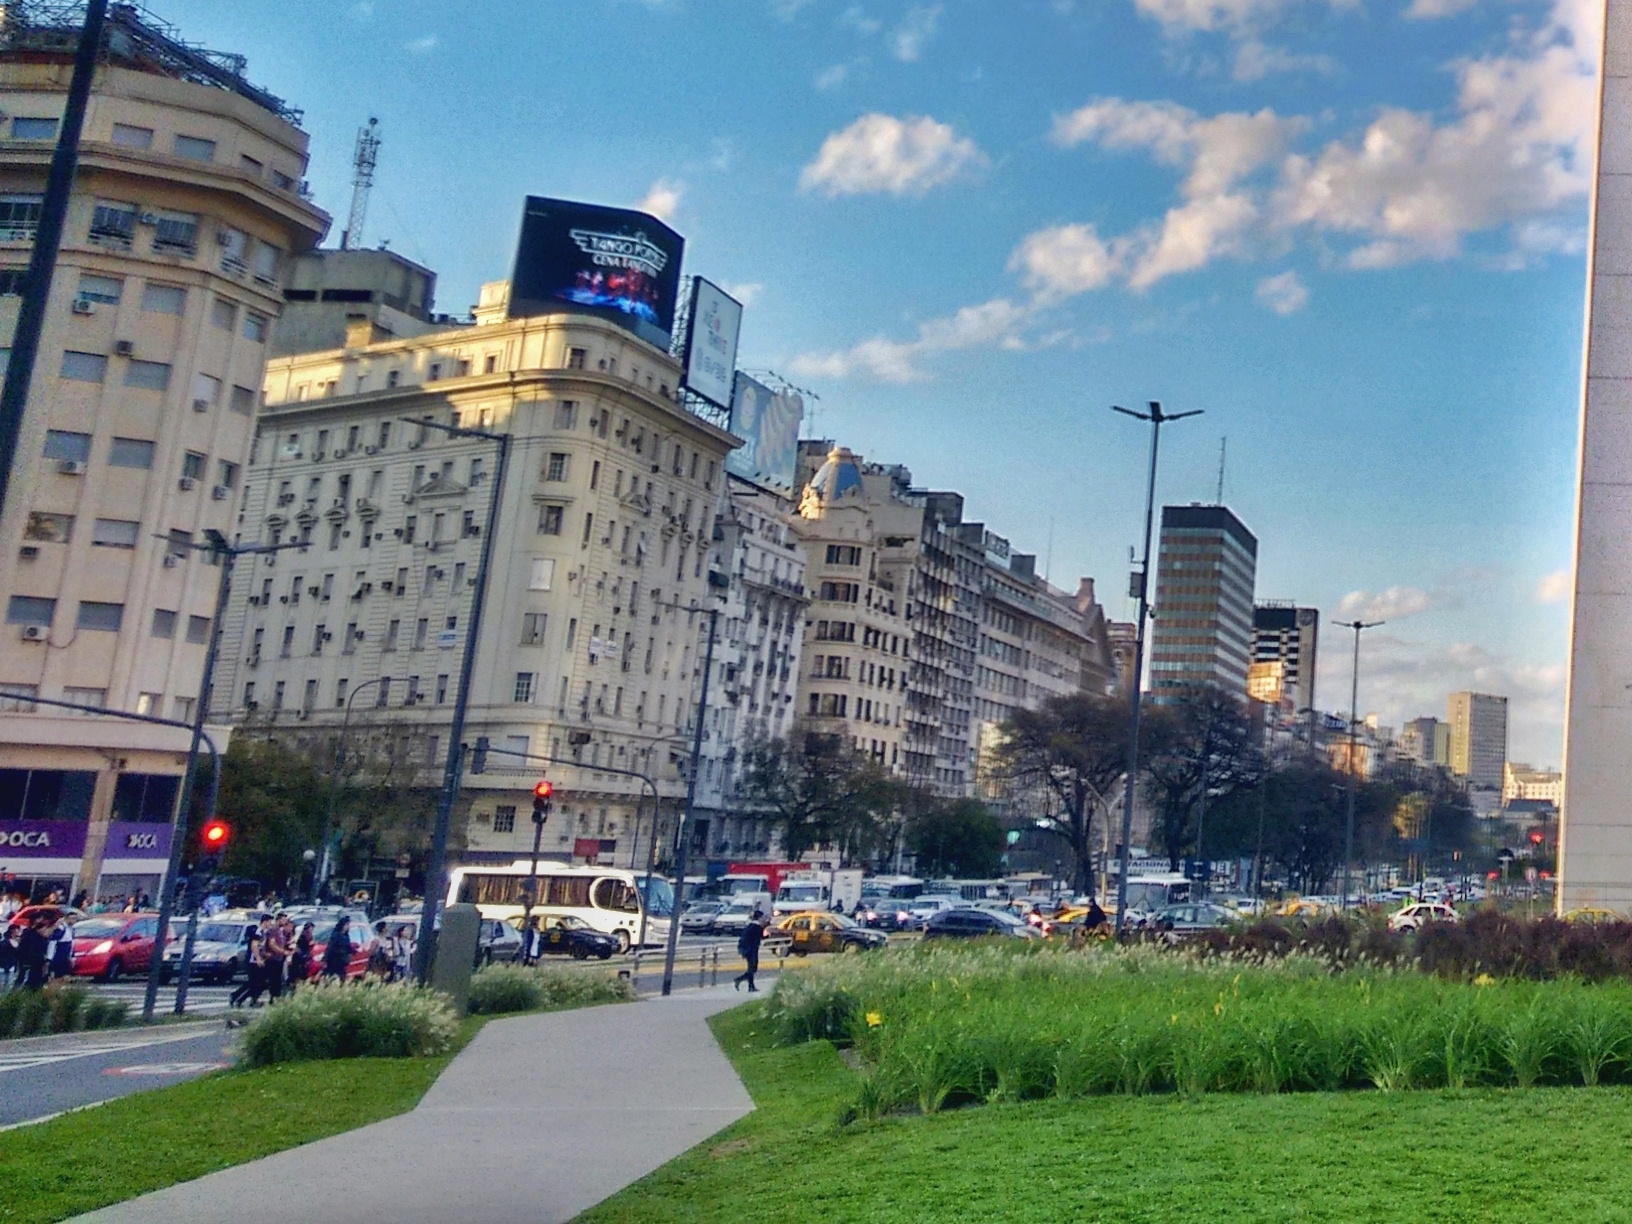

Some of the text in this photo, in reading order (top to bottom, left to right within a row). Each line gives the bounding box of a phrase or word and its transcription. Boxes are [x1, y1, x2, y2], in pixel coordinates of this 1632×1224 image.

[590, 237, 632, 254] TANGO
[593, 255, 620, 267] CENA
[9, 831, 50, 847] OCA
[139, 833, 157, 848] OCA
